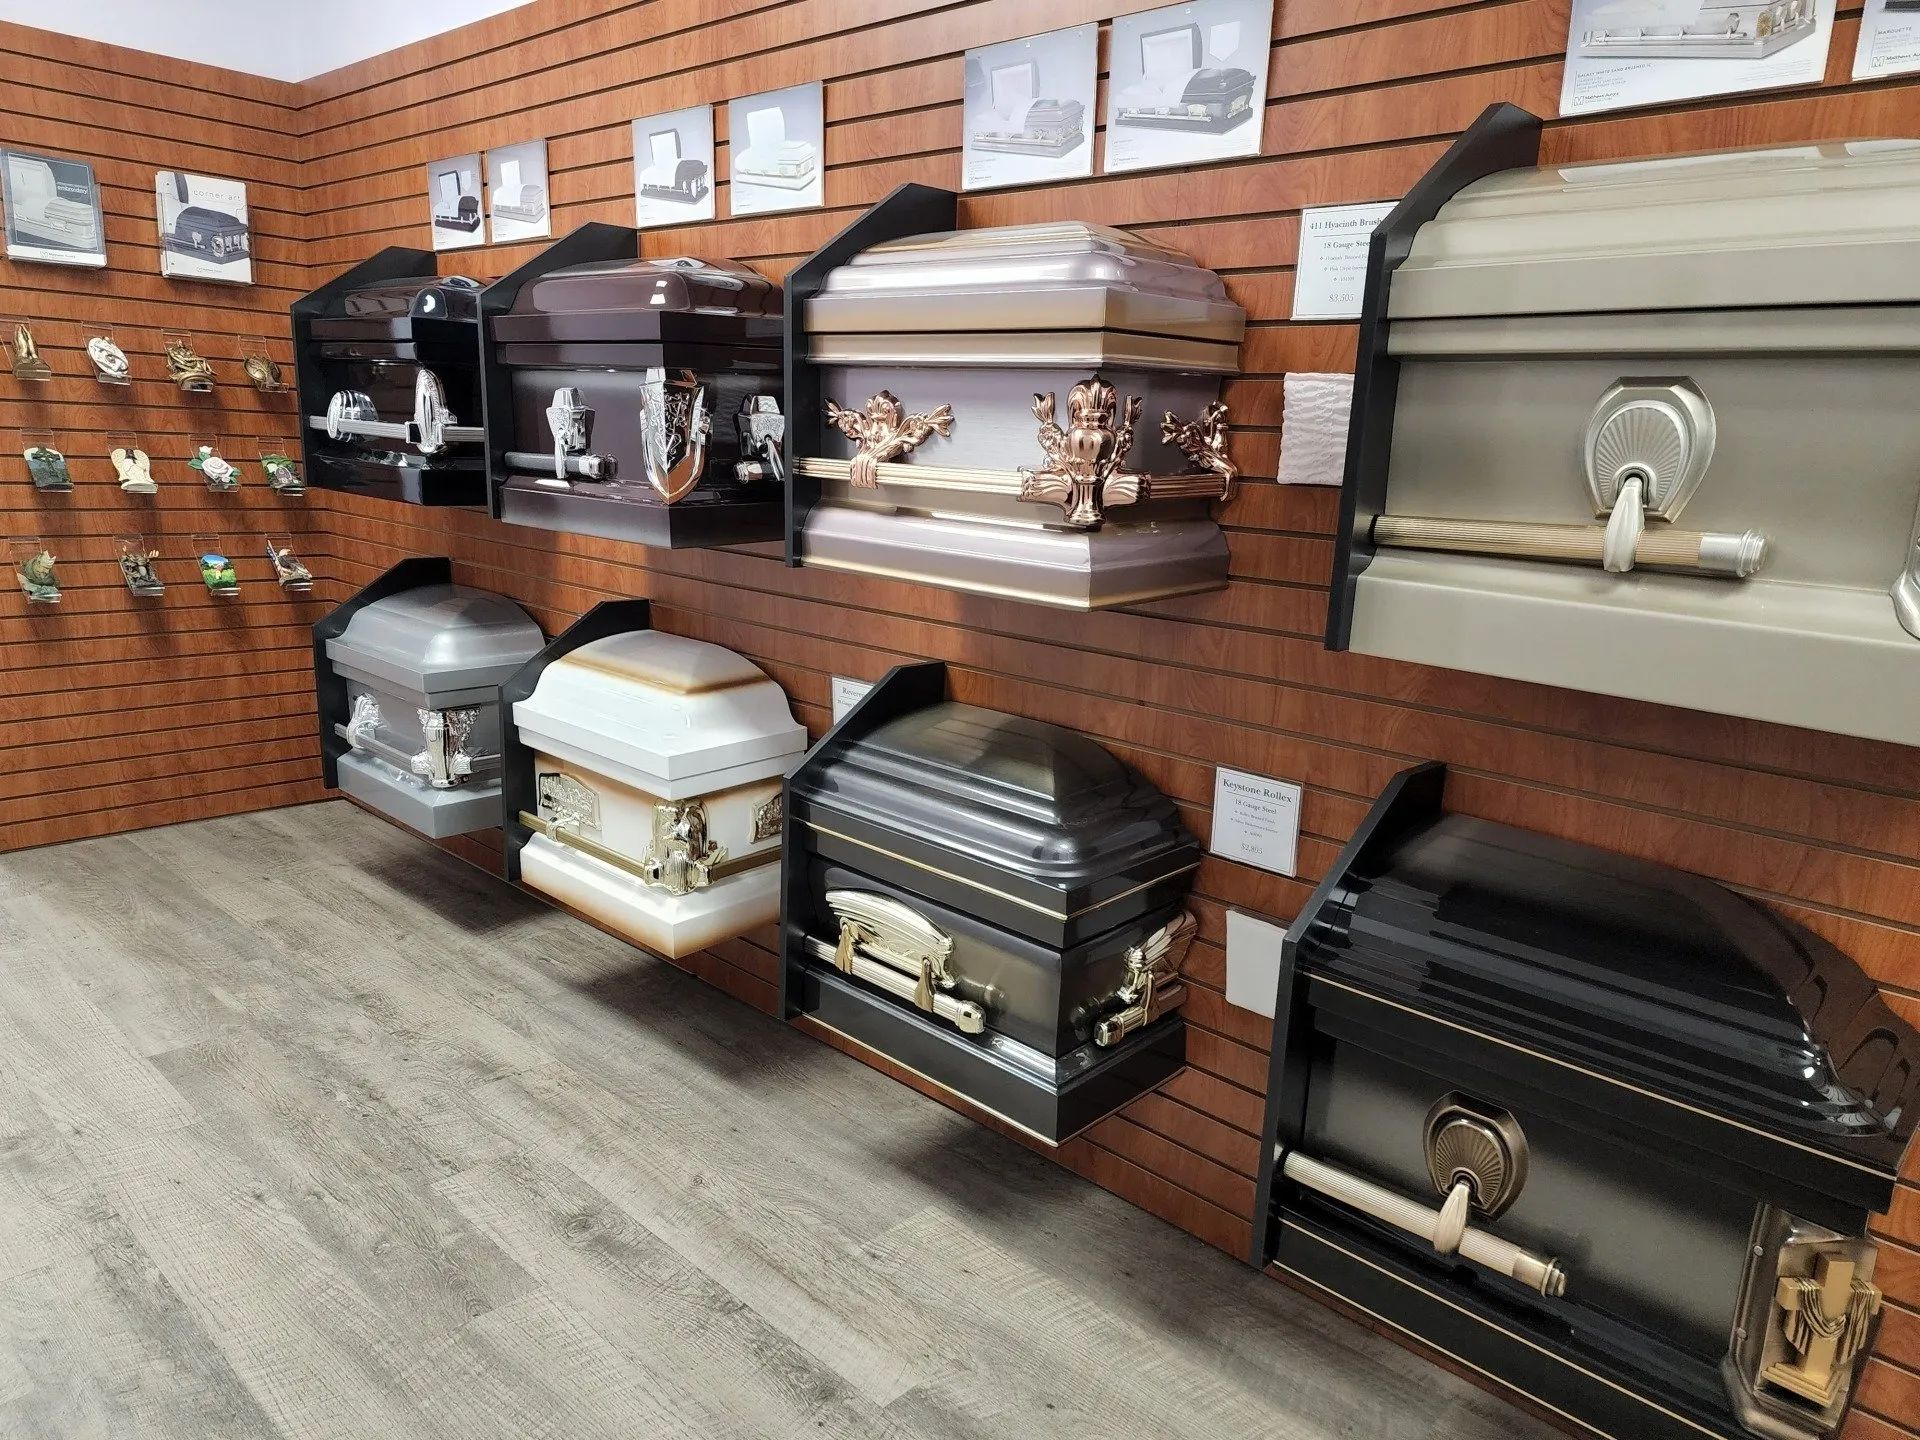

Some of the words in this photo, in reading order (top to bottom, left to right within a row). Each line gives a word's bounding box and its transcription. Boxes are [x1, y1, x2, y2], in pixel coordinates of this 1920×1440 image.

[1310, 222, 1322, 230] 411
[1324, 219, 1357, 230] Hyacinth
[1332, 241, 1354, 251] Gauge
[1223, 778, 1261, 795] Keystone
[1263, 788, 1292, 803] Rollex
[1243, 801, 1261, 811] Gauge
[1262, 806, 1277, 814] Steel
